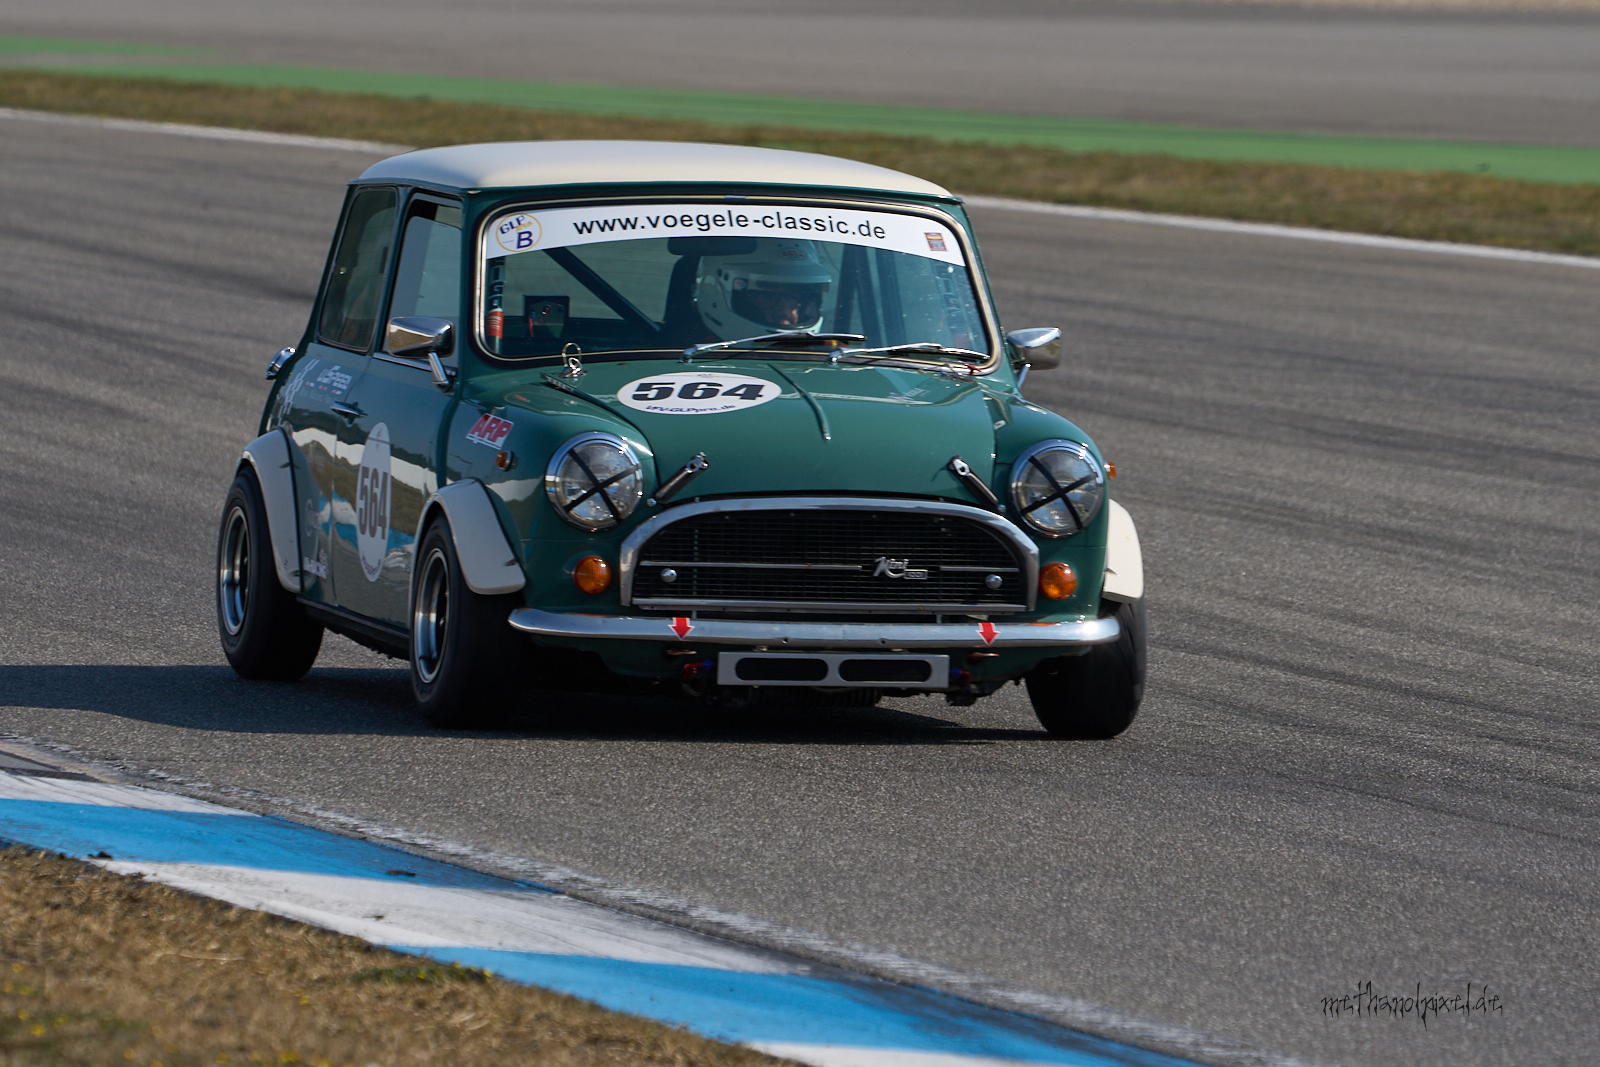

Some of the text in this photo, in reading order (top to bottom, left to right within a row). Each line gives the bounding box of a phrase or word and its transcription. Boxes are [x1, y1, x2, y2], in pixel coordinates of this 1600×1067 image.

[499, 215, 524, 234] GLP
[573, 209, 887, 239] www.voegele-classic.de
[516, 230, 533, 249] B
[632, 382, 765, 401] 564
[469, 414, 512, 443] ARP
[359, 466, 388, 540] 564
